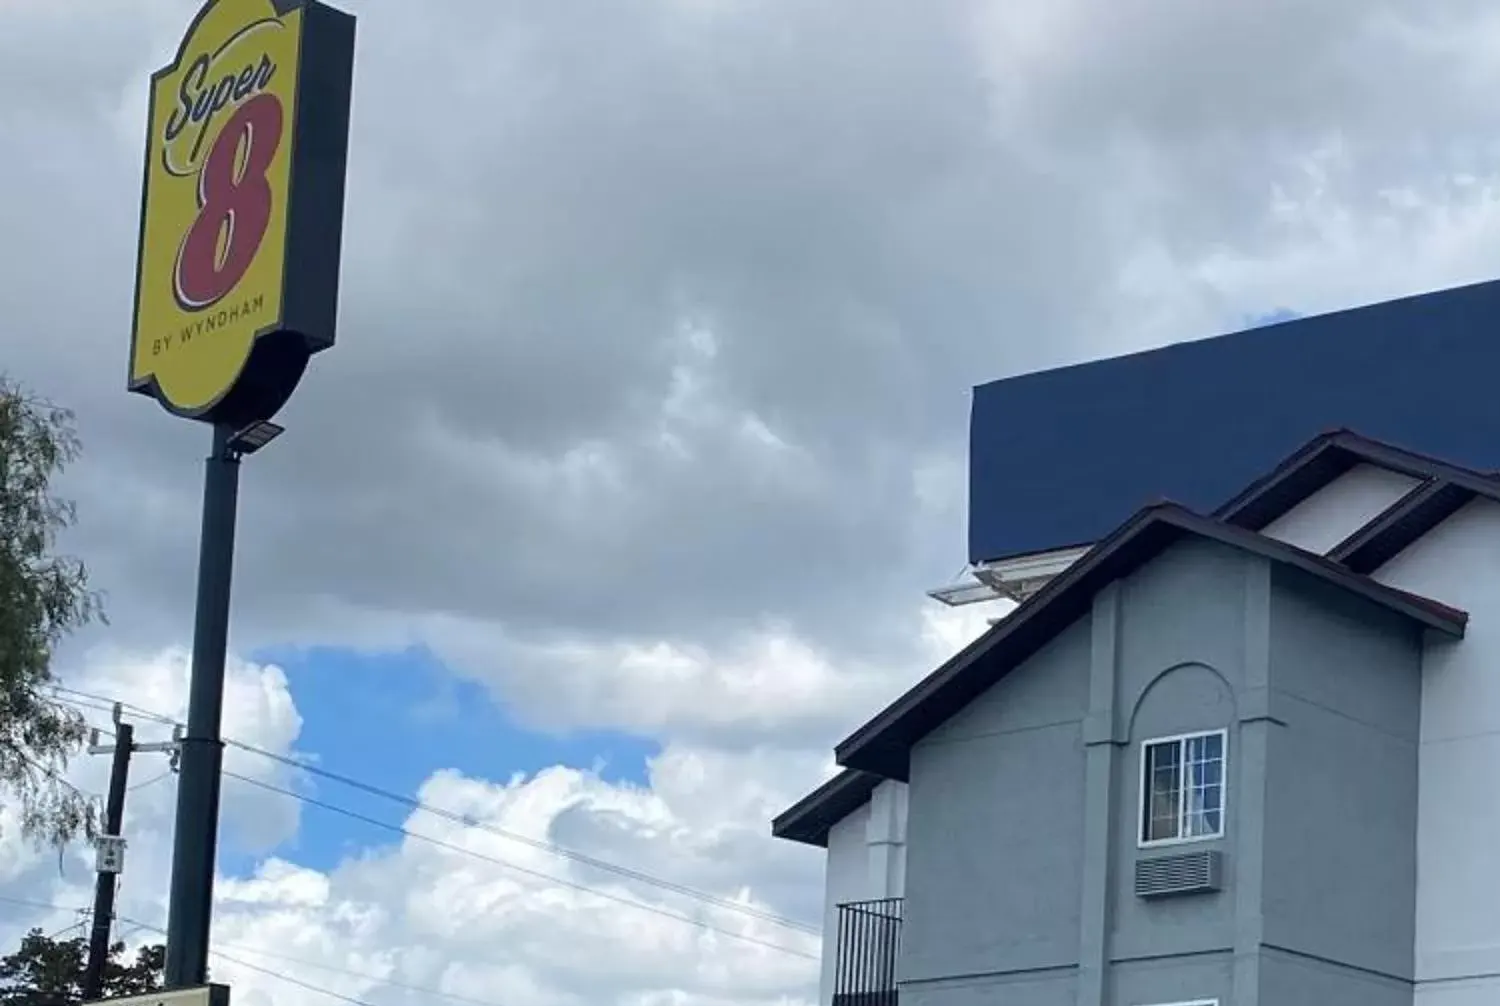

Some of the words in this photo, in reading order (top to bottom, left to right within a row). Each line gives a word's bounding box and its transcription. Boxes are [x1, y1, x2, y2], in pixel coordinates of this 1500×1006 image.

[163, 52, 277, 172] Super
[172, 92, 284, 313] 8
[152, 335, 172, 356] BY
[180, 294, 264, 343] WYNDHAM
